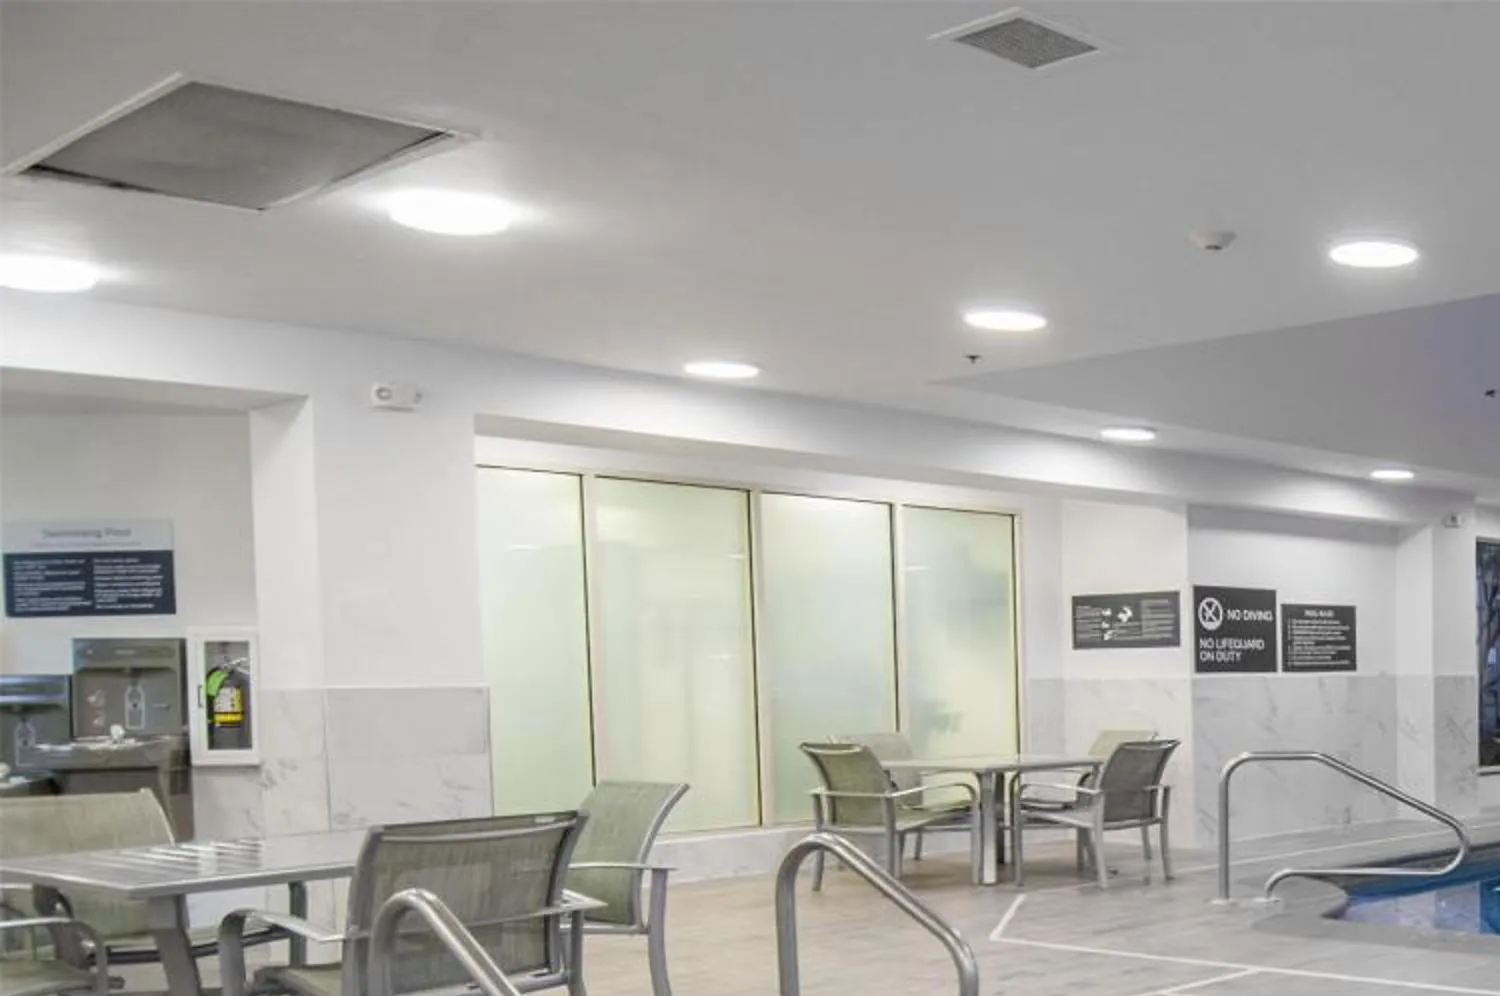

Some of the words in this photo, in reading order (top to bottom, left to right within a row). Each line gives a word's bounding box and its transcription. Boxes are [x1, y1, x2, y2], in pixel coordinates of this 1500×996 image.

[1227, 609, 1241, 621] NO
[1243, 609, 1273, 622] DIVING
[1200, 637, 1214, 649] NO
[1215, 637, 1265, 651] LIFEGUARD
[1200, 650, 1214, 662] ON
[1215, 650, 1242, 663] DUTY
